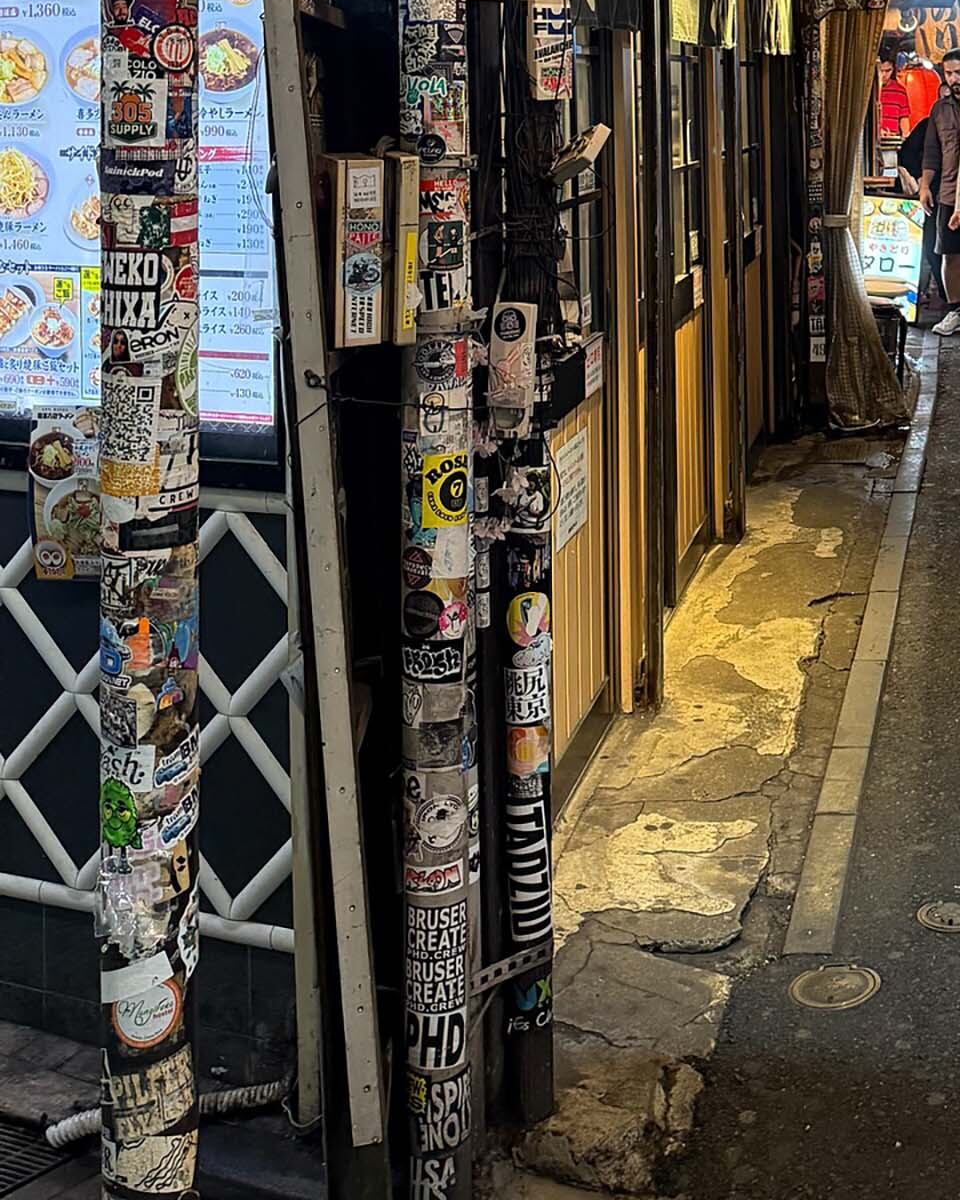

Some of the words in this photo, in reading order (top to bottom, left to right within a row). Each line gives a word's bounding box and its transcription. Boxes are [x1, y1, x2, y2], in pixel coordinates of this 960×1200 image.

[22, 2, 60, 19] ¥1,360
[111, 101, 153, 124] 305
[110, 124, 153, 136] SUPPLY
[159, 488, 194, 506] CREW
[505, 694, 548, 719] 東京
[407, 902, 466, 930] BRUSER
[407, 922, 466, 951] CREATE
[406, 954, 464, 982] BRUSER
[406, 974, 465, 1004] CREATE
[407, 1012, 465, 1068] PHD
